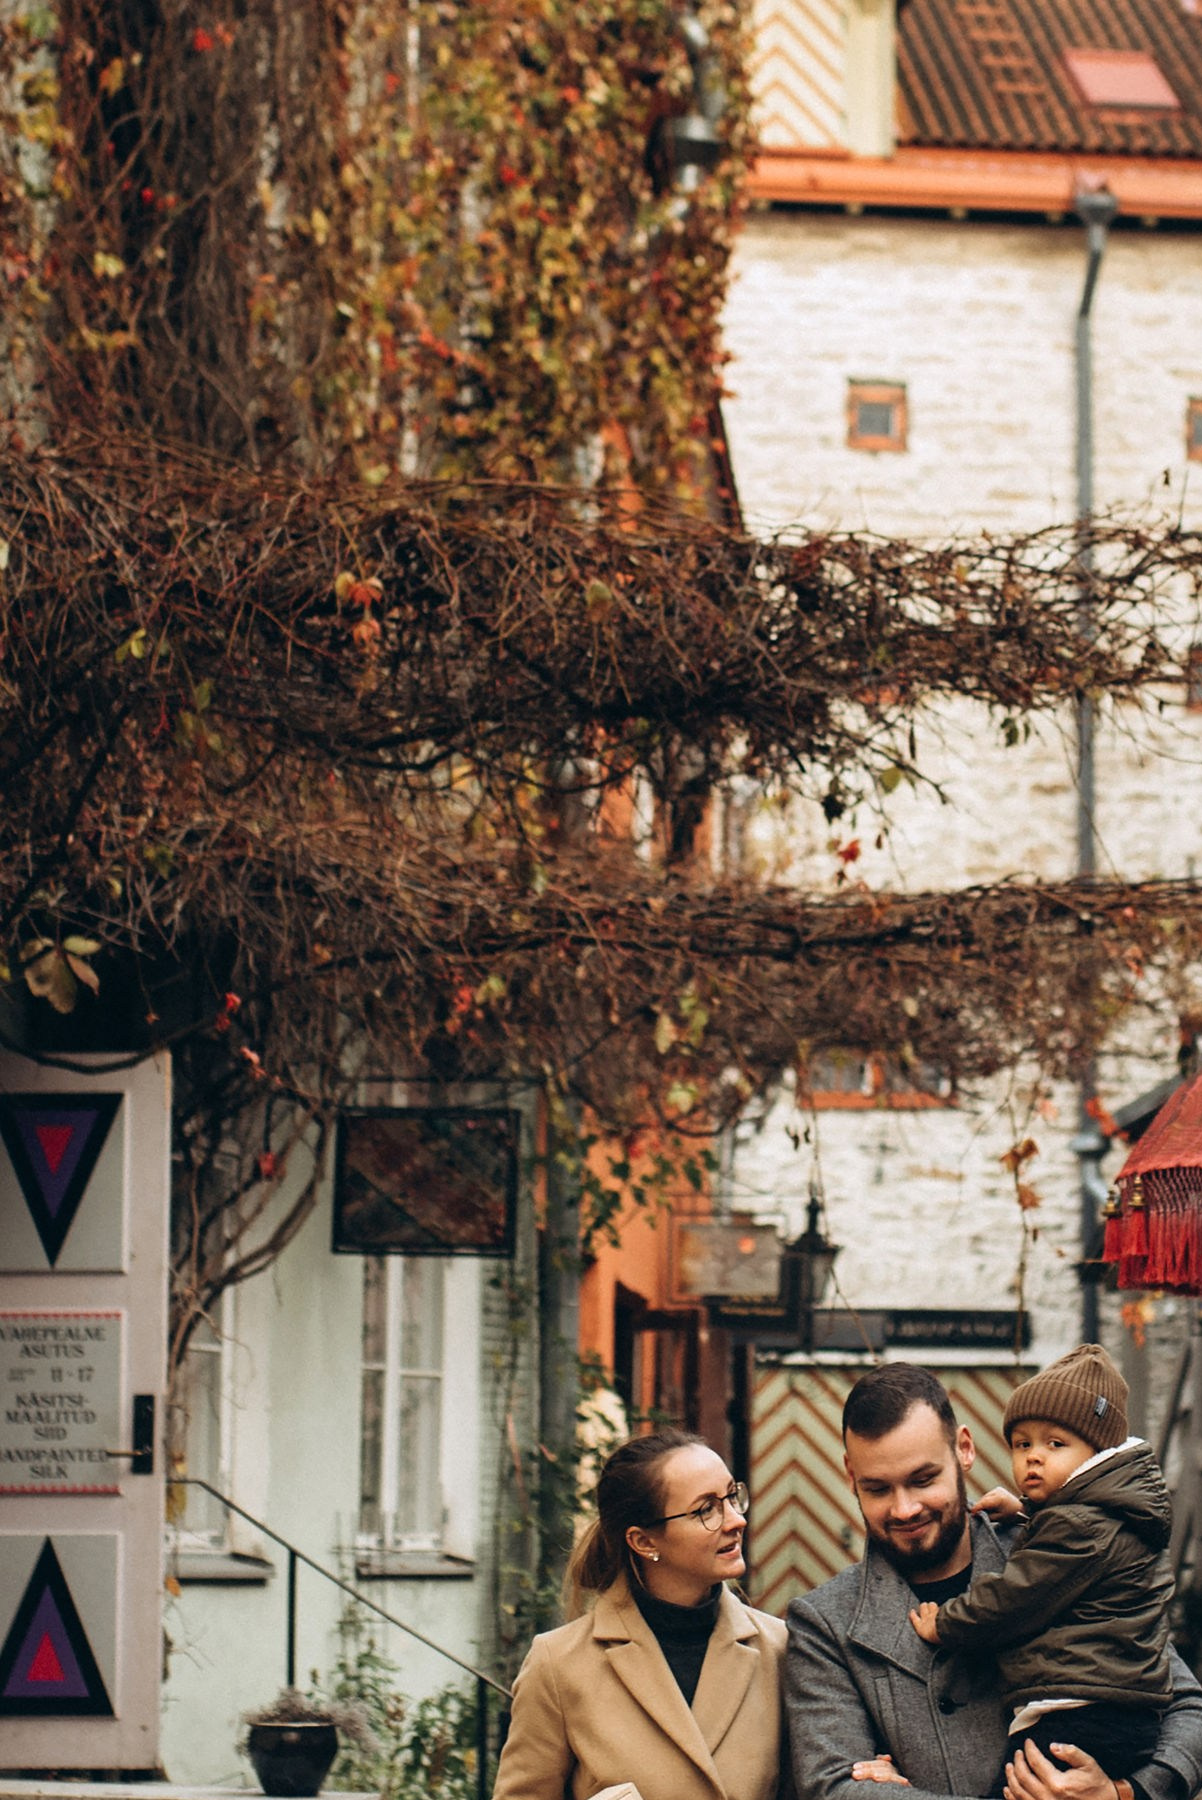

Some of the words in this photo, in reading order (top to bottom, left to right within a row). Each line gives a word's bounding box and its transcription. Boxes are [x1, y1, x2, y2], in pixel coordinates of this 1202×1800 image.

[20, 1344, 85, 1358] ASUTUS
[50, 1367, 63, 1382] 11
[78, 1366, 95, 1382] 17
[5, 1410, 97, 1425] MAALITUD
[29, 1464, 69, 1479] SILK
